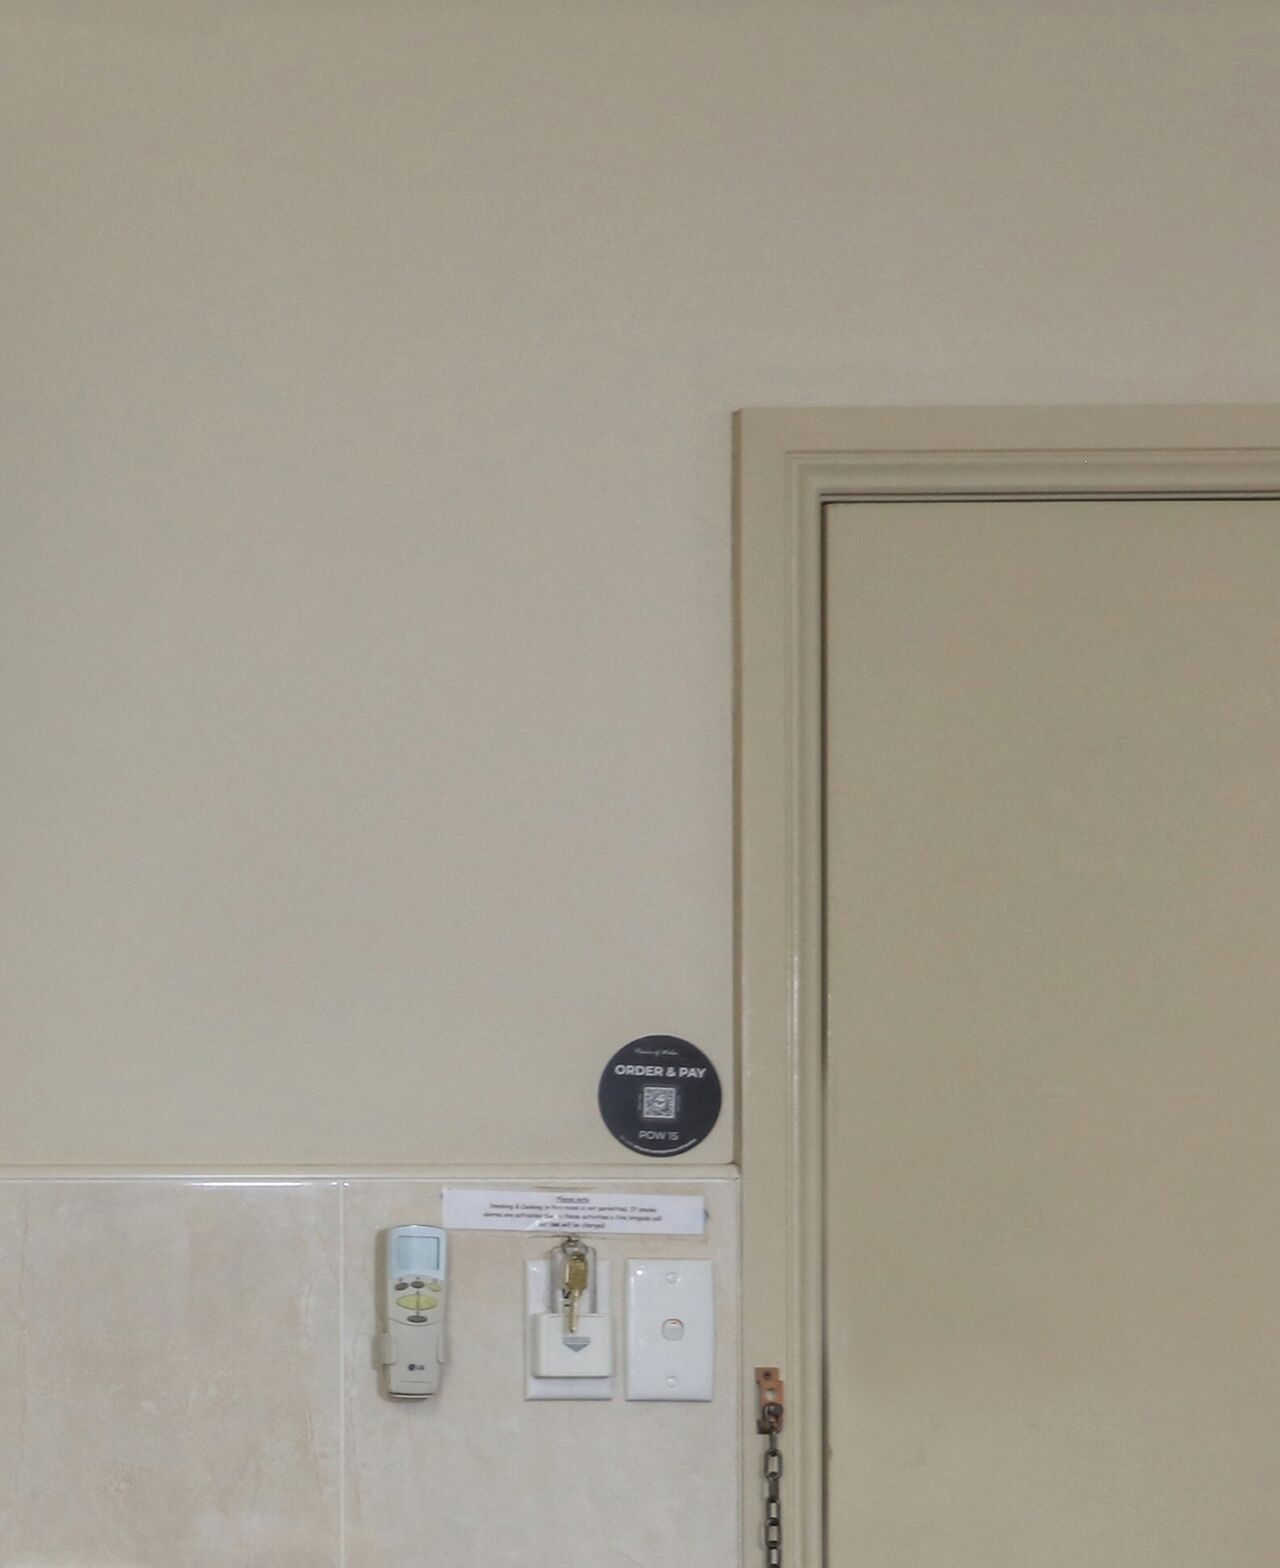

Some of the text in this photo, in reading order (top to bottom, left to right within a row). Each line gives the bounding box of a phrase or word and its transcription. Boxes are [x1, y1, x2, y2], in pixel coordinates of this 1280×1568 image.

[613, 1064, 708, 1079] ORDER & PAY
[638, 1129, 680, 1142] POW 15
